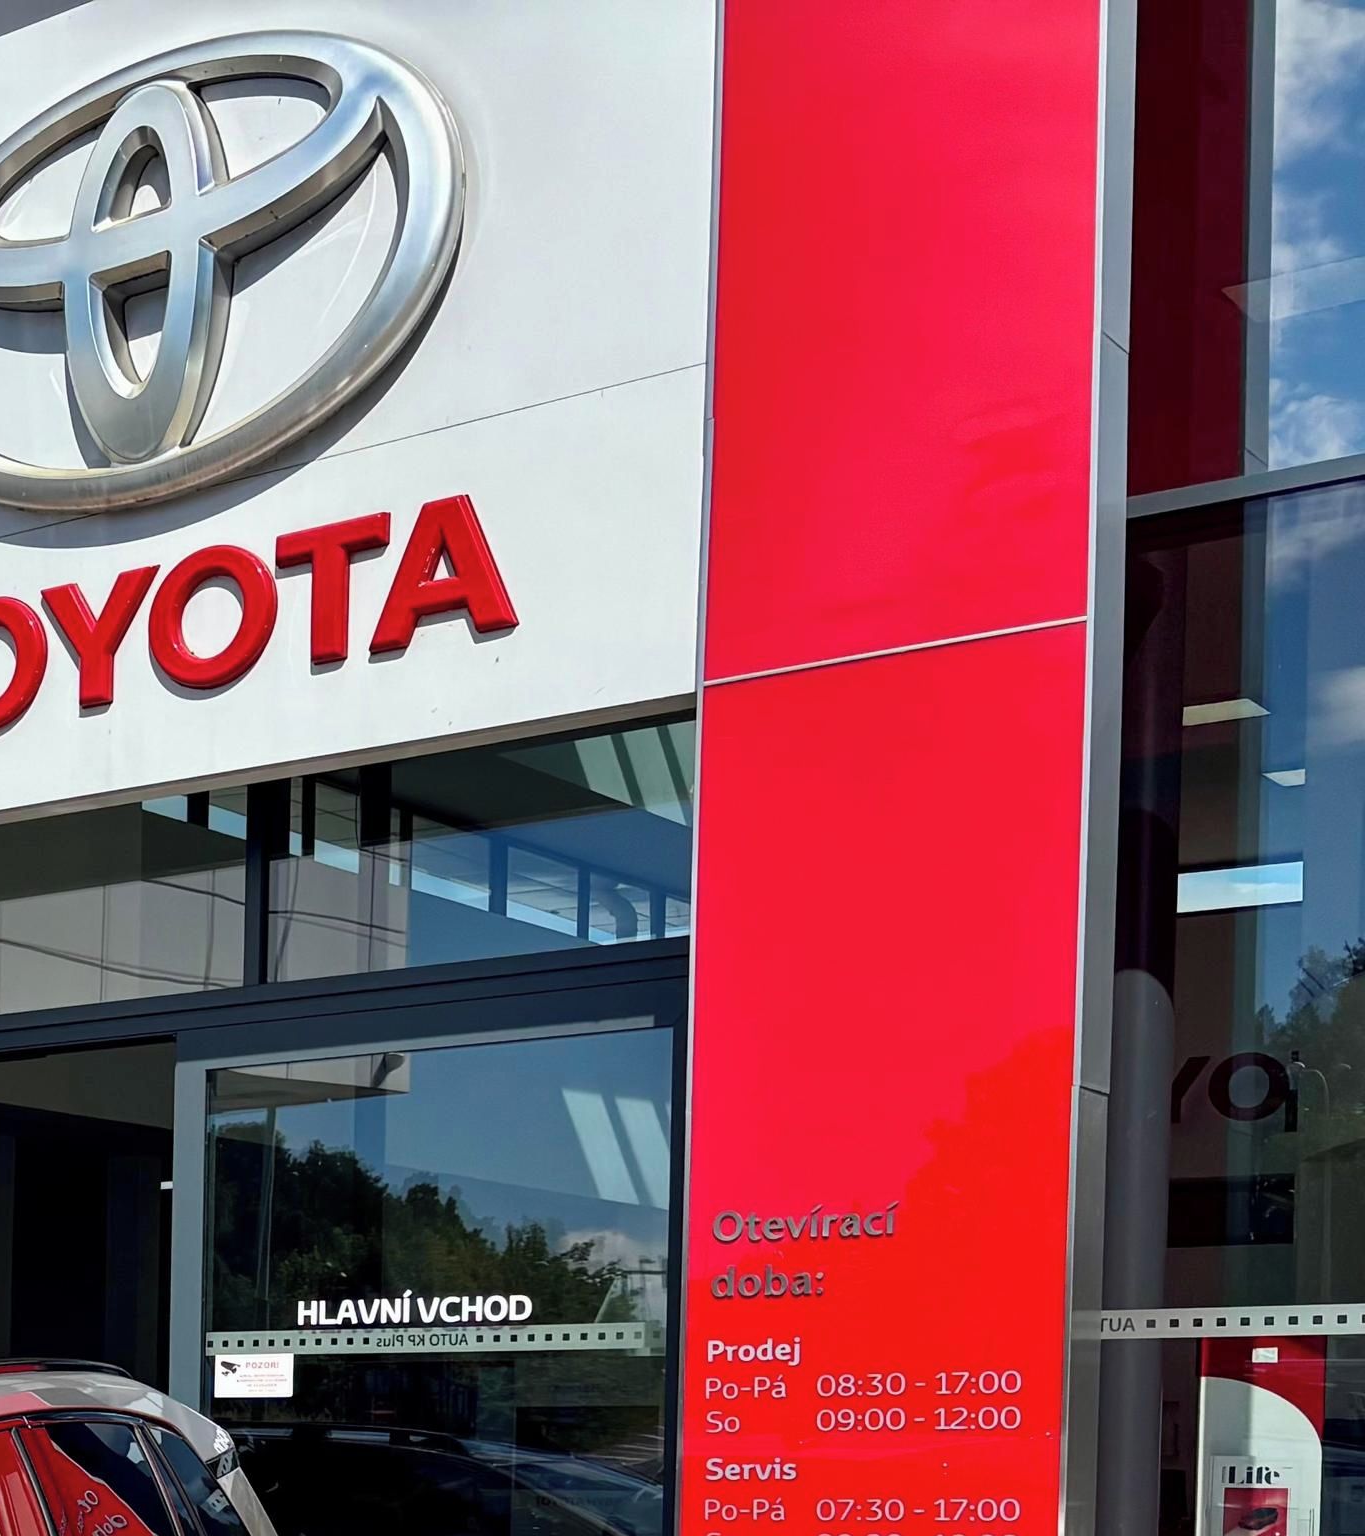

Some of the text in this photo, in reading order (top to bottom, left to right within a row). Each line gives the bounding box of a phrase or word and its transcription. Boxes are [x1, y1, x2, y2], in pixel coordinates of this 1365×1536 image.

[712, 1201, 899, 1243] Otevírací
[710, 1265, 825, 1299] doba:
[297, 1289, 533, 1326] HLAVNÍ VCHOD
[707, 1337, 801, 1366] Prodej
[705, 1374, 787, 1400] Po-Pá
[816, 1372, 906, 1398] 08:30
[935, 1370, 1022, 1395] 17:00
[706, 1411, 741, 1434] So
[816, 1408, 906, 1432] 09:00
[934, 1406, 1021, 1431] 12:00
[706, 1457, 797, 1481] Servis
[704, 1497, 786, 1521] Po-Pá
[816, 1499, 905, 1522] 07:30
[934, 1498, 1021, 1522] 17:00
